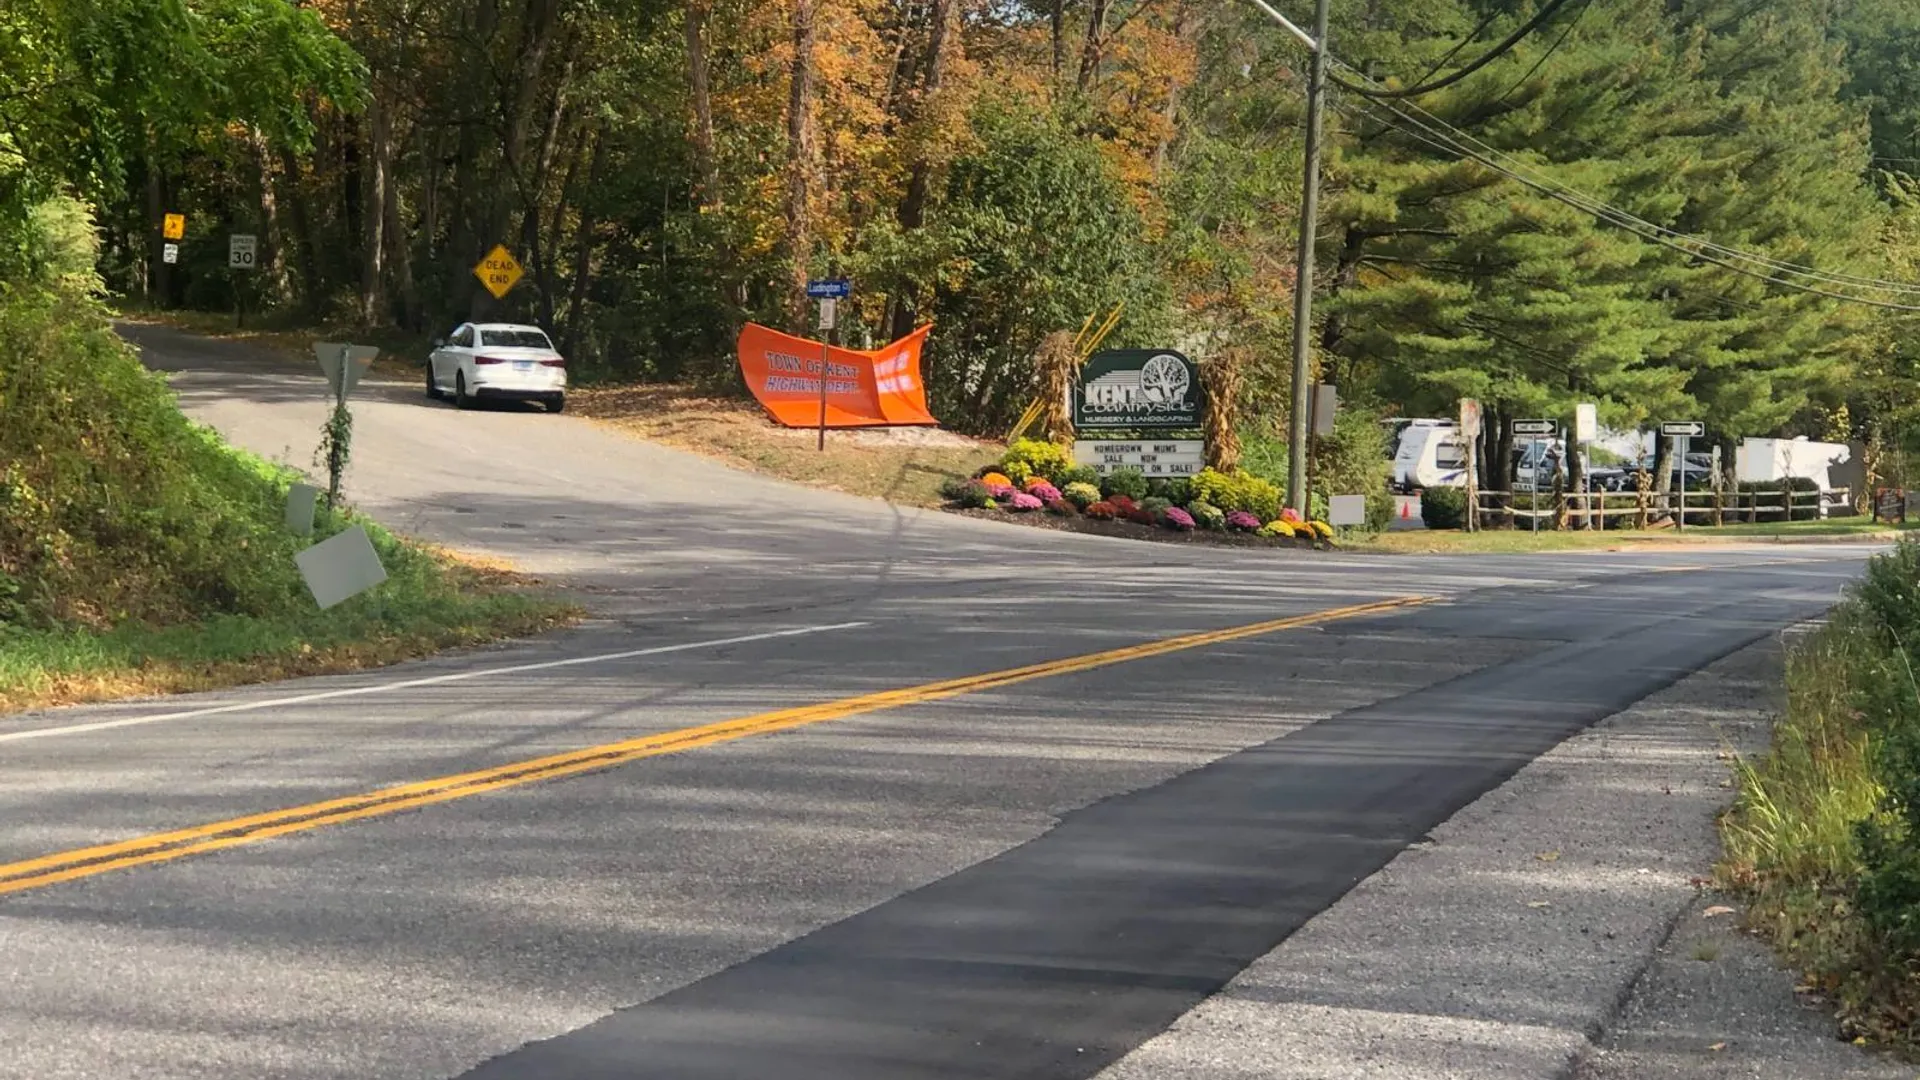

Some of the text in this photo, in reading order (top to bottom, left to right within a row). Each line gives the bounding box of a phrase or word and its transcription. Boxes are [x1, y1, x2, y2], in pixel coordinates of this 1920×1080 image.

[232, 251, 252, 264] 30
[486, 261, 514, 270] DEAD
[490, 274, 509, 284] END
[766, 351, 801, 373] TOWN
[805, 359, 821, 374] OF
[825, 362, 858, 378] KENT
[1085, 384, 1140, 405] KENT
[1094, 445, 1177, 453] HOMEGROWN MUMS
[1104, 455, 1157, 463] SALE NOW
[1151, 464, 1162, 473] ON
[1170, 464, 1193, 473] SALE!
